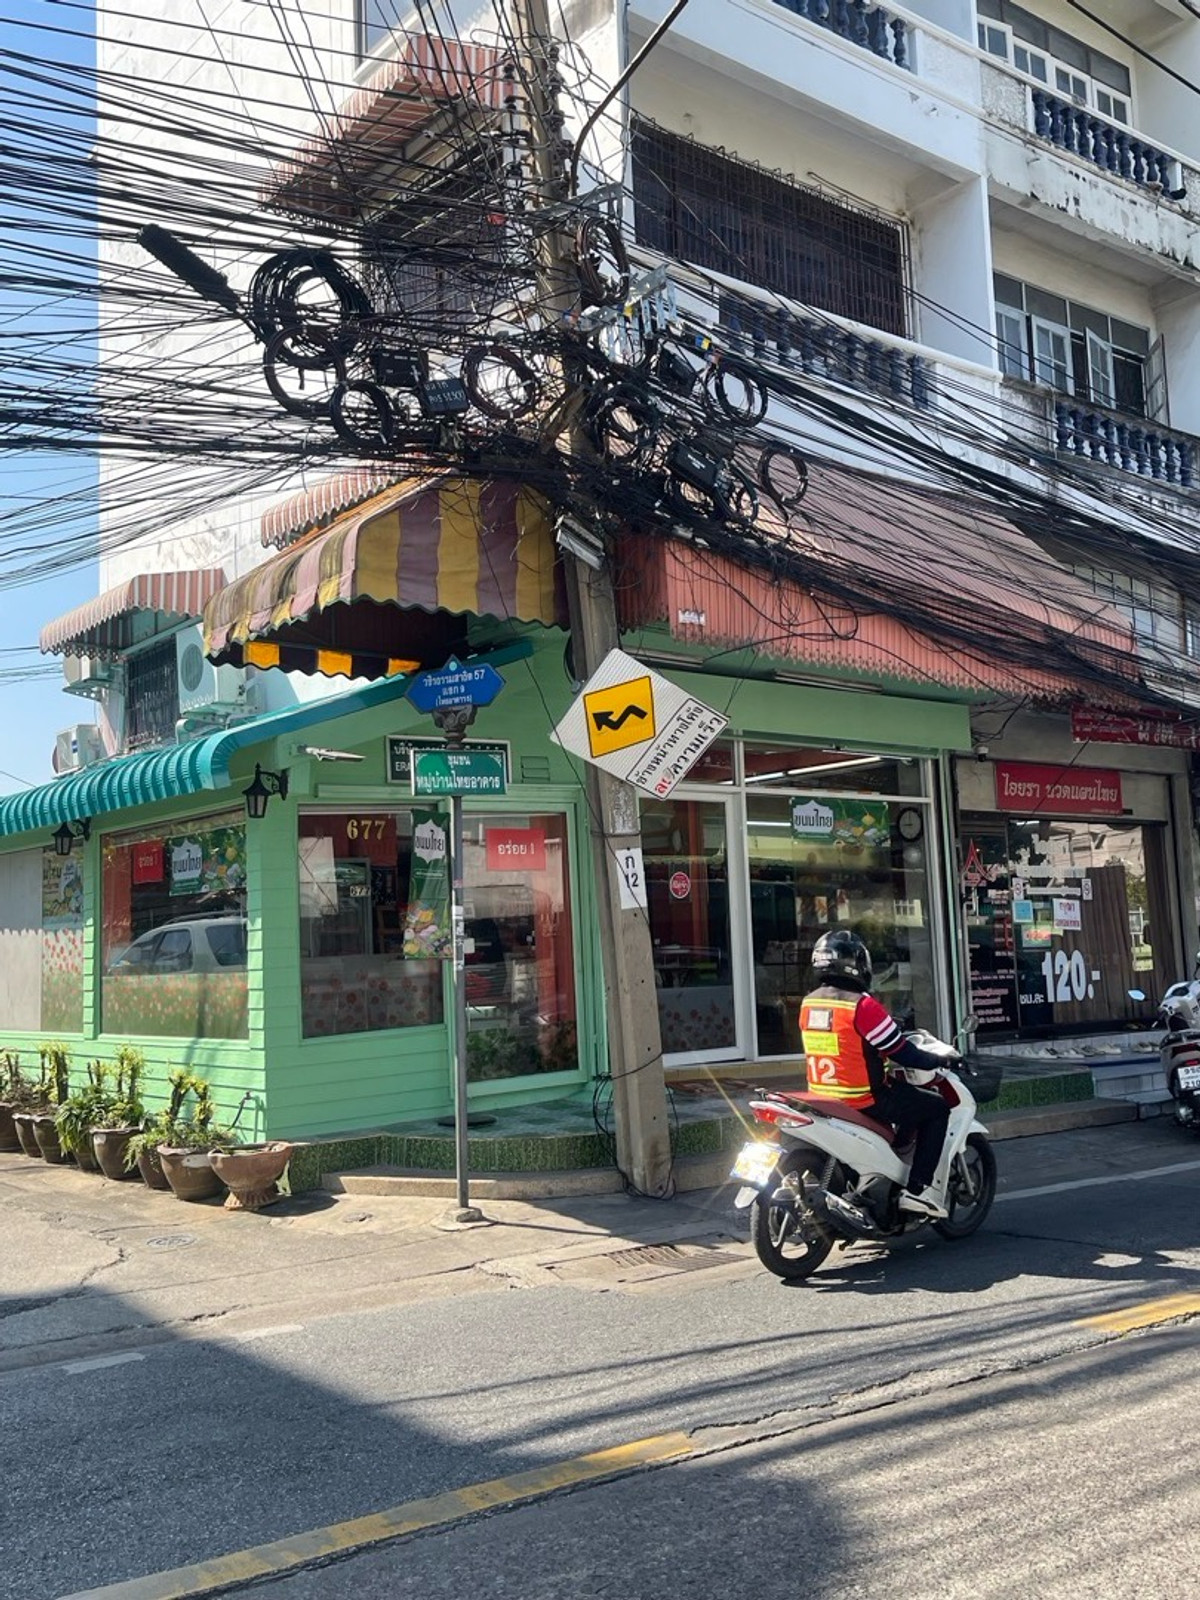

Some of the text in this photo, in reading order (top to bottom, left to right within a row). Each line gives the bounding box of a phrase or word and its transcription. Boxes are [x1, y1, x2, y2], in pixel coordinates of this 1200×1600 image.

[474, 669, 485, 680] 57
[416, 770, 500, 793] หมู่บ้านไทยอาคาร
[347, 819, 386, 840] 677
[498, 839, 527, 855] อร่อย
[625, 855, 635, 869] ก
[808, 1056, 838, 1084] 12
